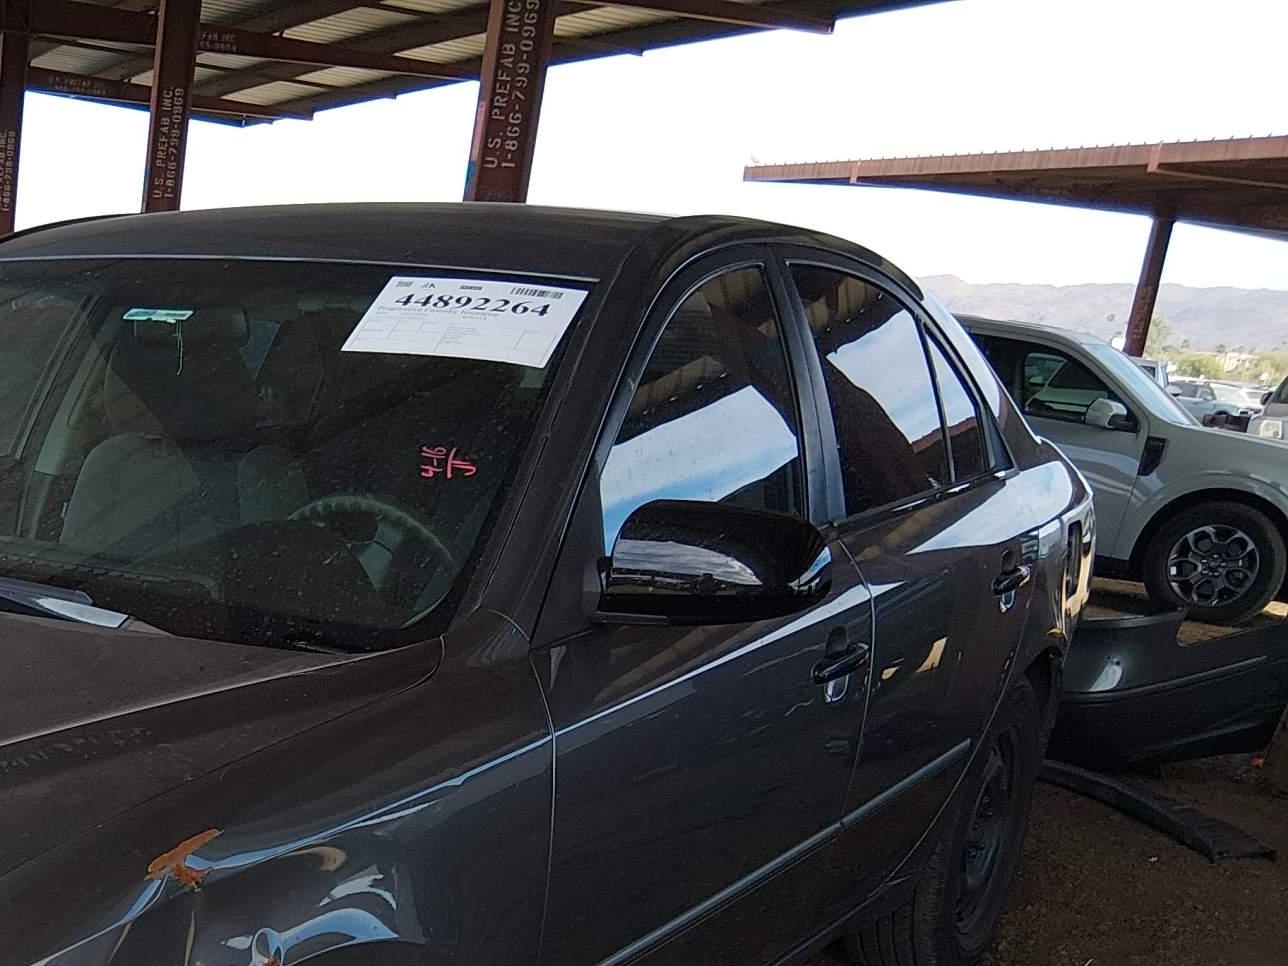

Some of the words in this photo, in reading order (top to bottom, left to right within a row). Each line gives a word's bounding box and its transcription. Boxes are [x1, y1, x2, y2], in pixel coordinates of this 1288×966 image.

[492, 43, 516, 120] PREFAB
[501, 0, 541, 168] 1-866-799-0969
[155, 117, 170, 167] PREFAB
[484, 131, 504, 168] U.S.
[395, 294, 551, 317] 44892264
